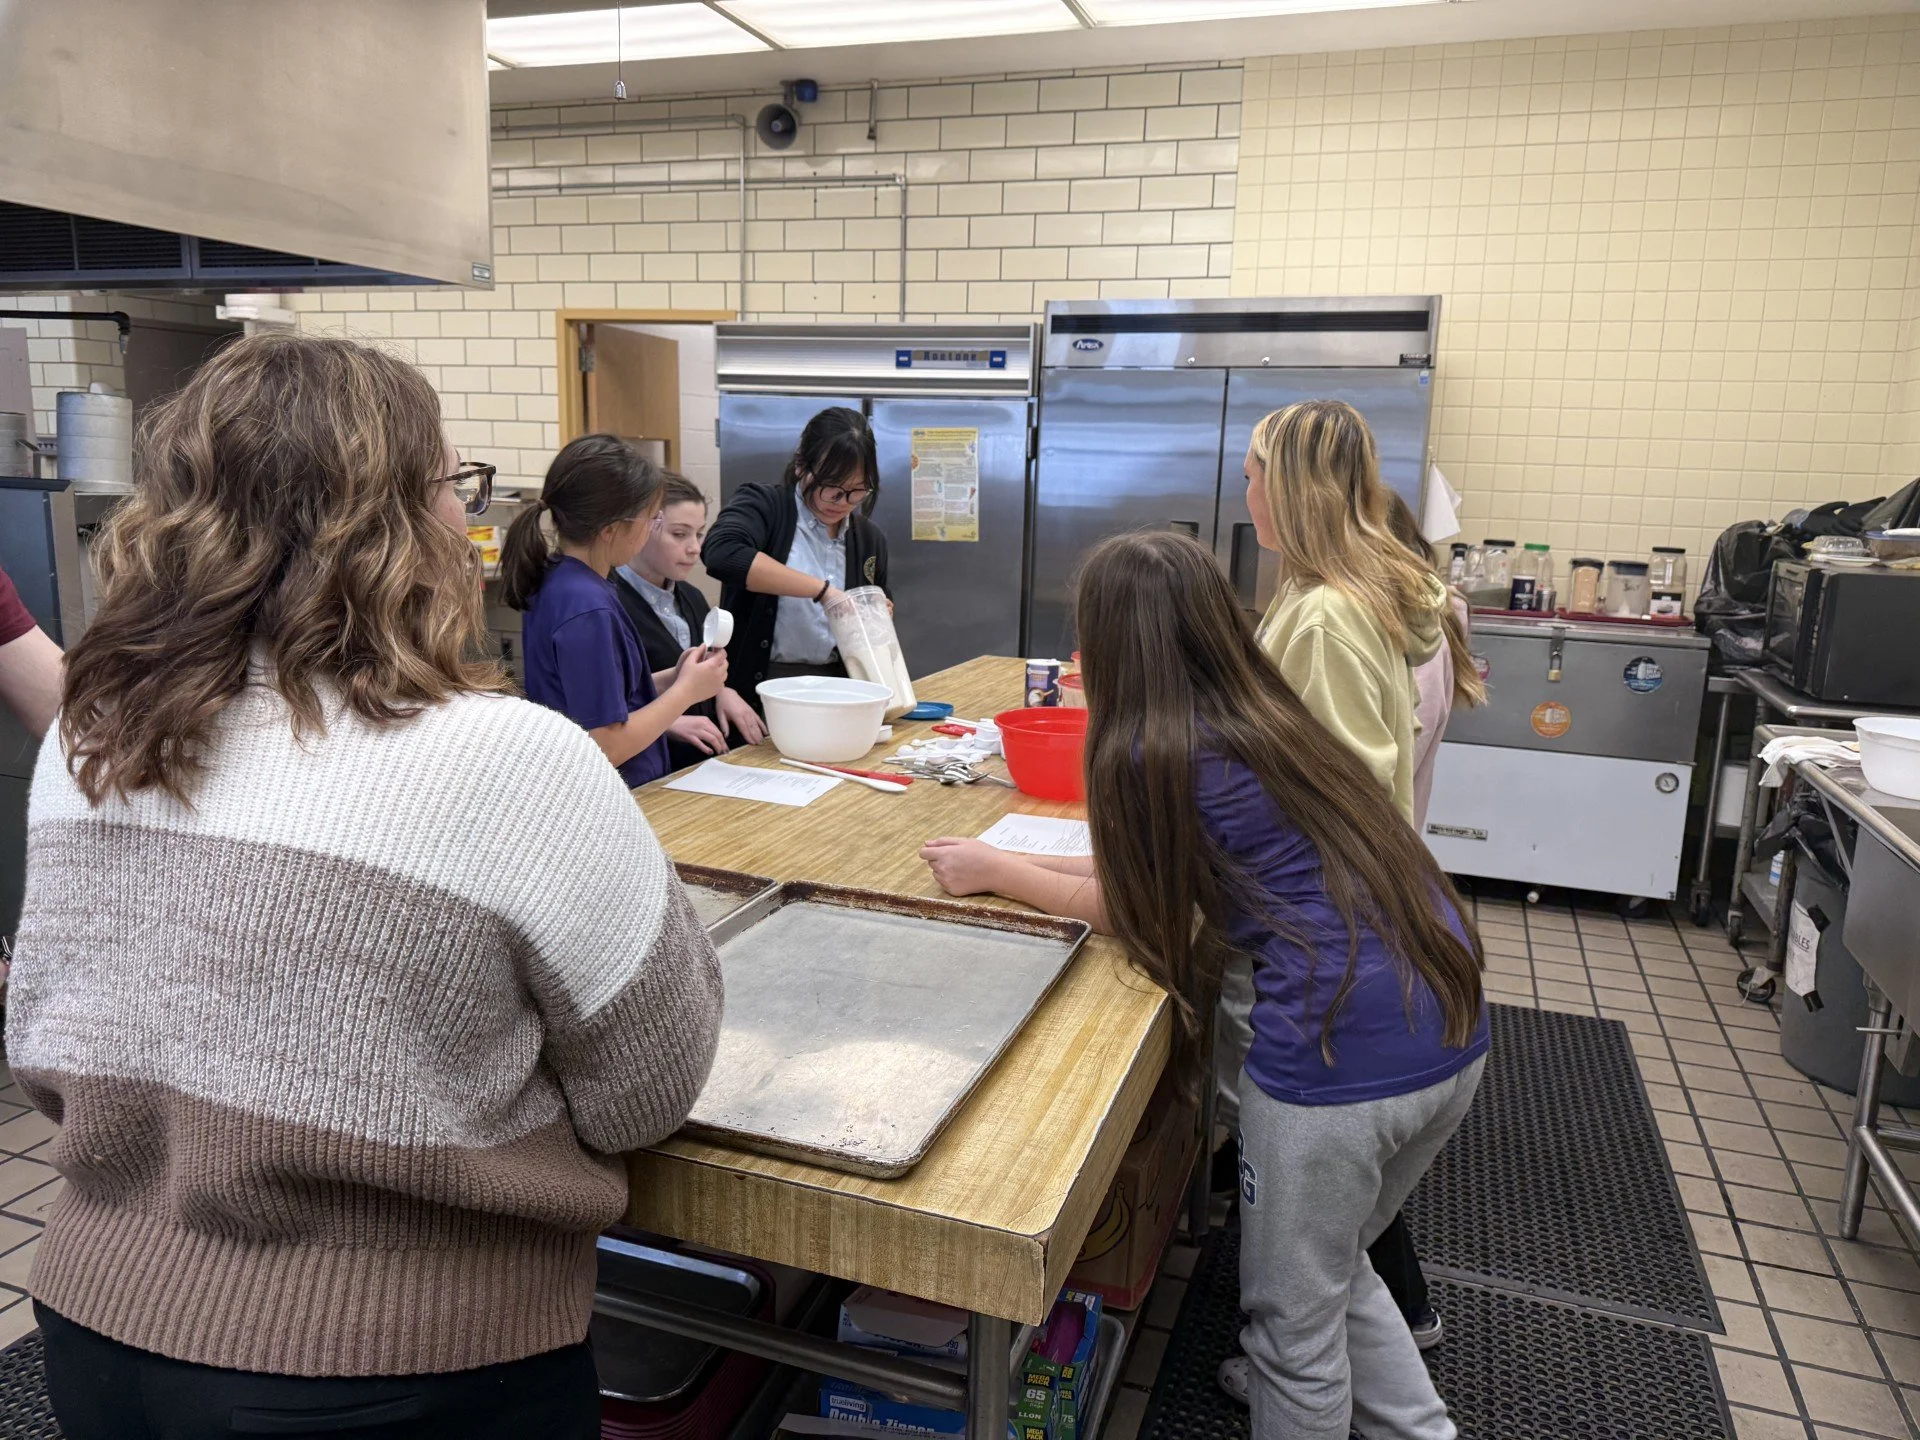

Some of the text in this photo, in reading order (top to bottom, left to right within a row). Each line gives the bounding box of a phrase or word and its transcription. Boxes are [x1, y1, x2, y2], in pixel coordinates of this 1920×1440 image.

[1025, 1389, 1046, 1401] 65
[831, 1396, 865, 1412] trueliving
[1018, 1411, 1043, 1420] LLON
[1062, 1414, 1074, 1423] 75
